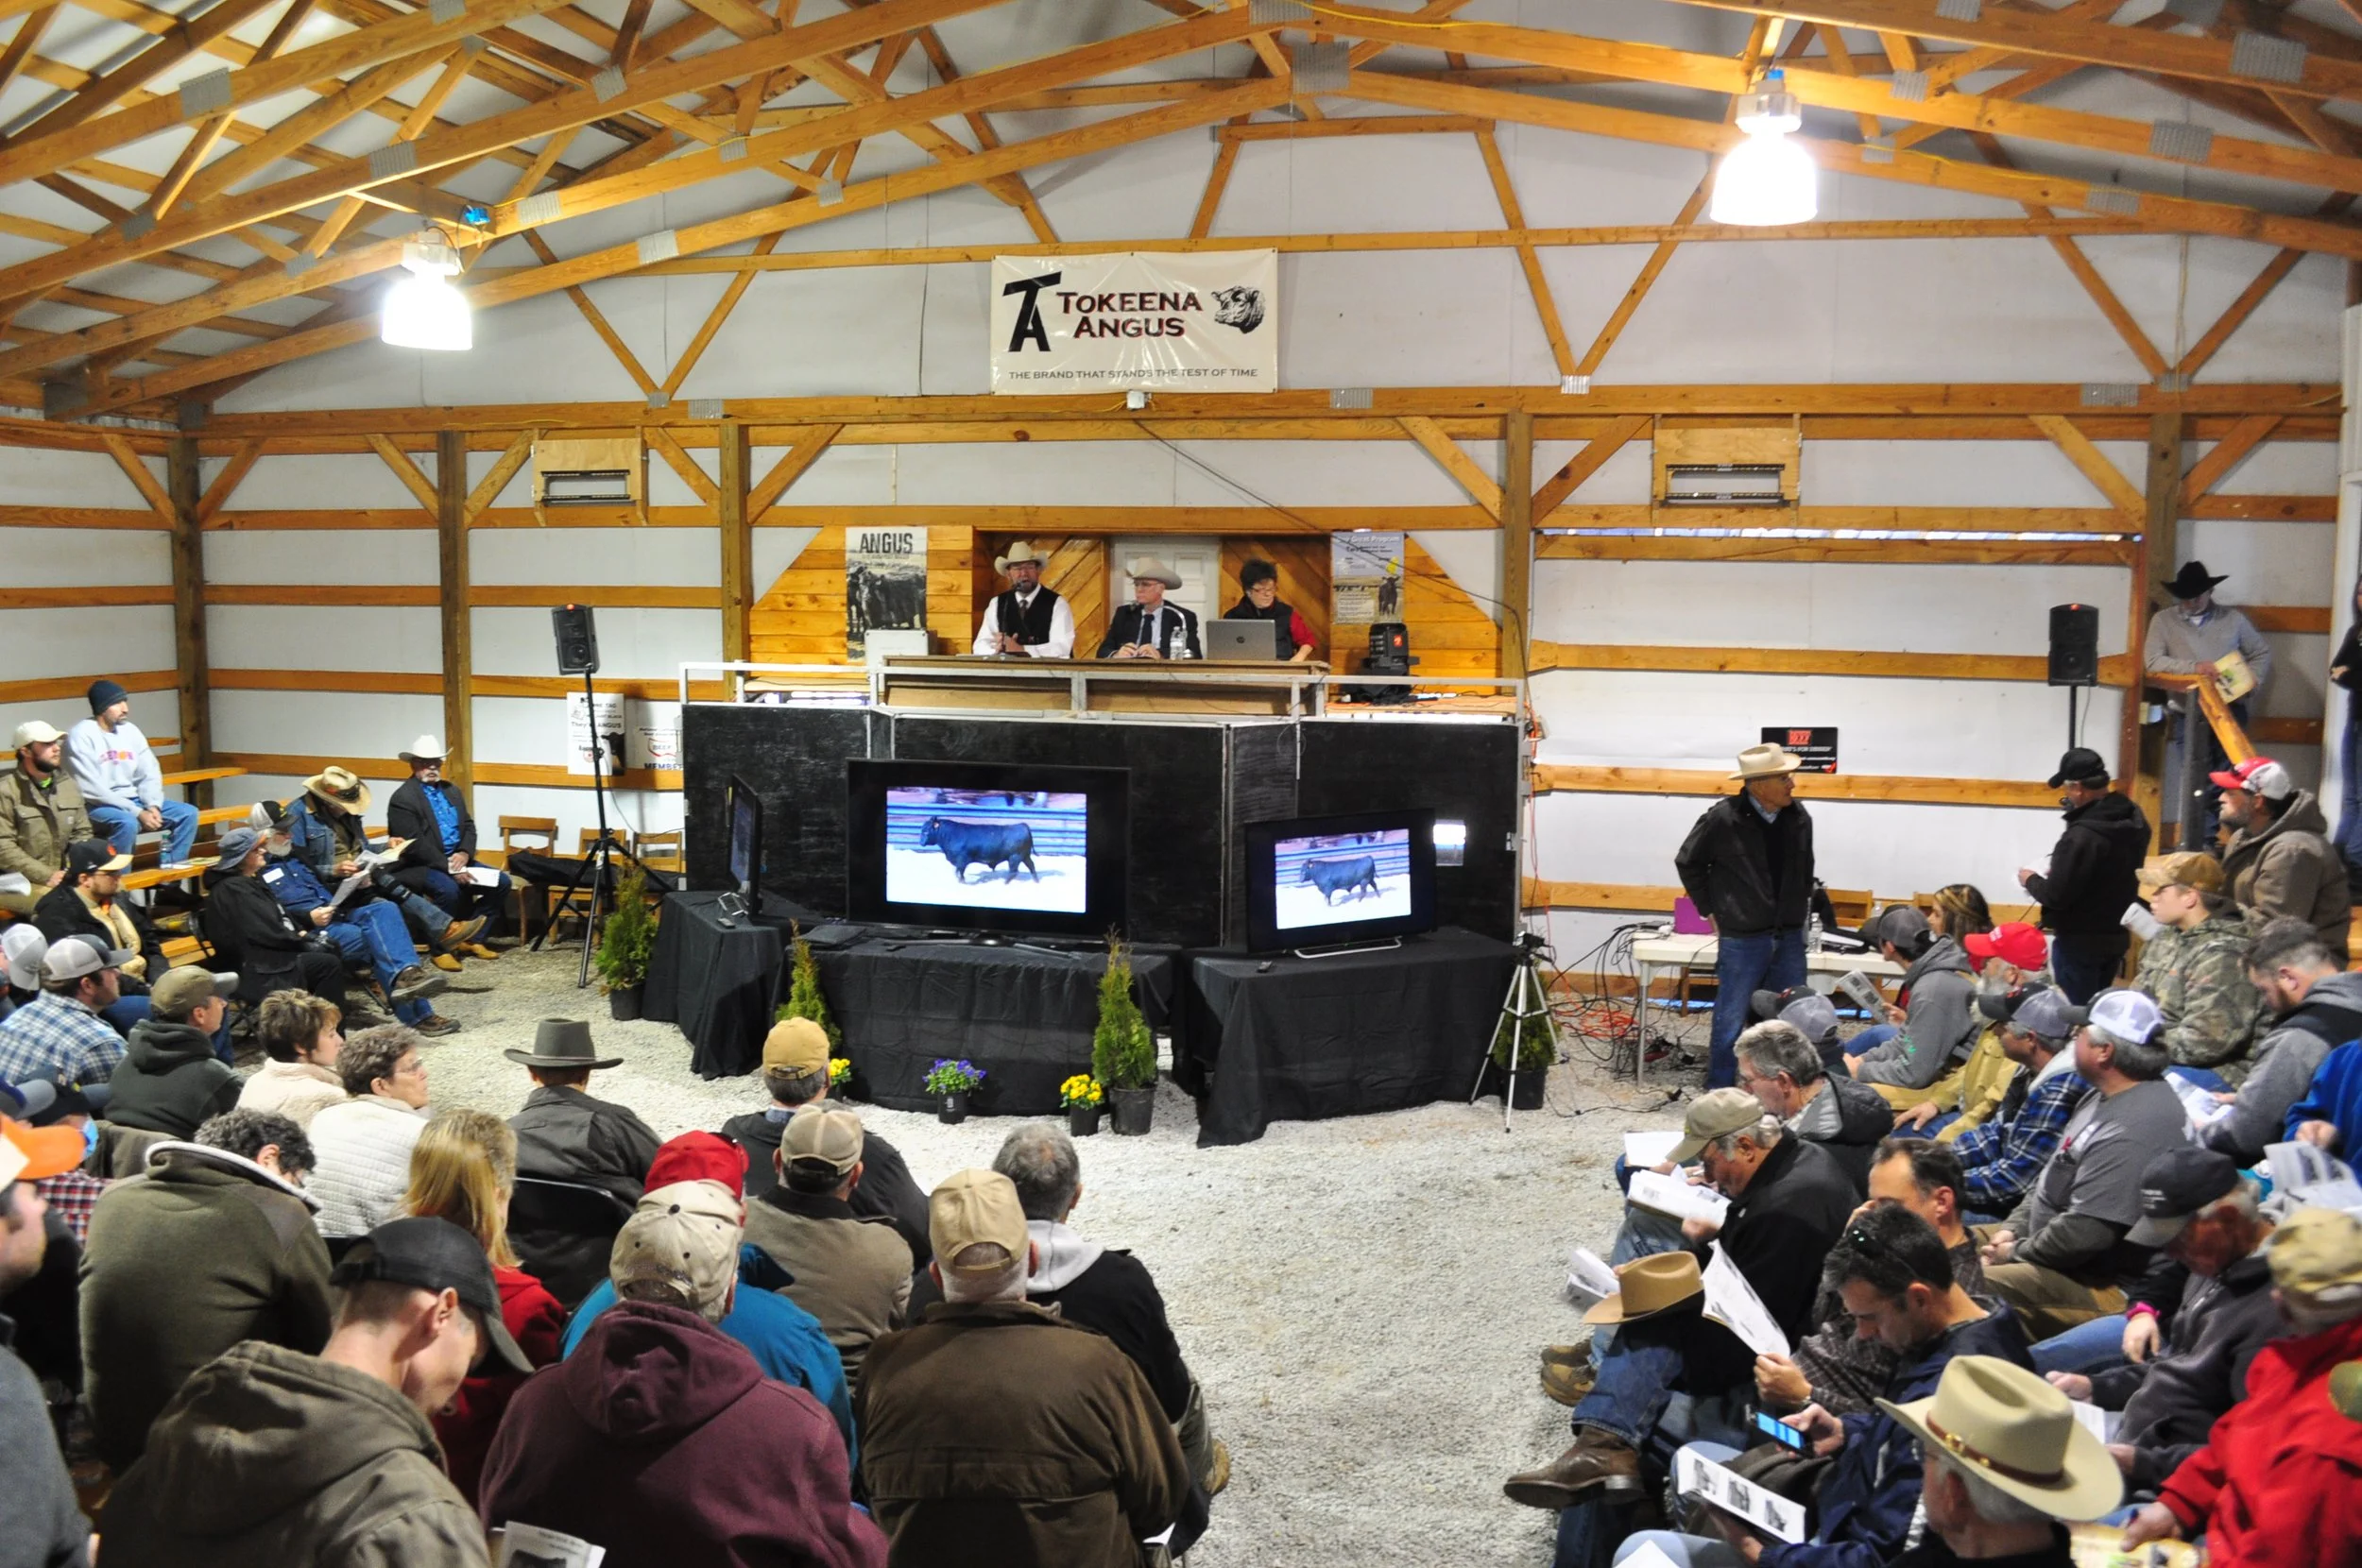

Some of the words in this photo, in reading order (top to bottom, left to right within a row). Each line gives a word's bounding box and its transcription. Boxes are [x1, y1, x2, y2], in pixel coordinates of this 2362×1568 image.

[1056, 291, 1204, 314] TOKEENA
[1073, 316, 1186, 338] ANGUS
[1034, 370, 1074, 379] BRAND
[1108, 369, 1154, 378] STANDS
[1155, 368, 1178, 377] THE
[1181, 368, 1209, 377] TEST
[1211, 368, 1227, 377] OF
[1229, 368, 1258, 377] TIME
[859, 533, 914, 554] ANGUS
